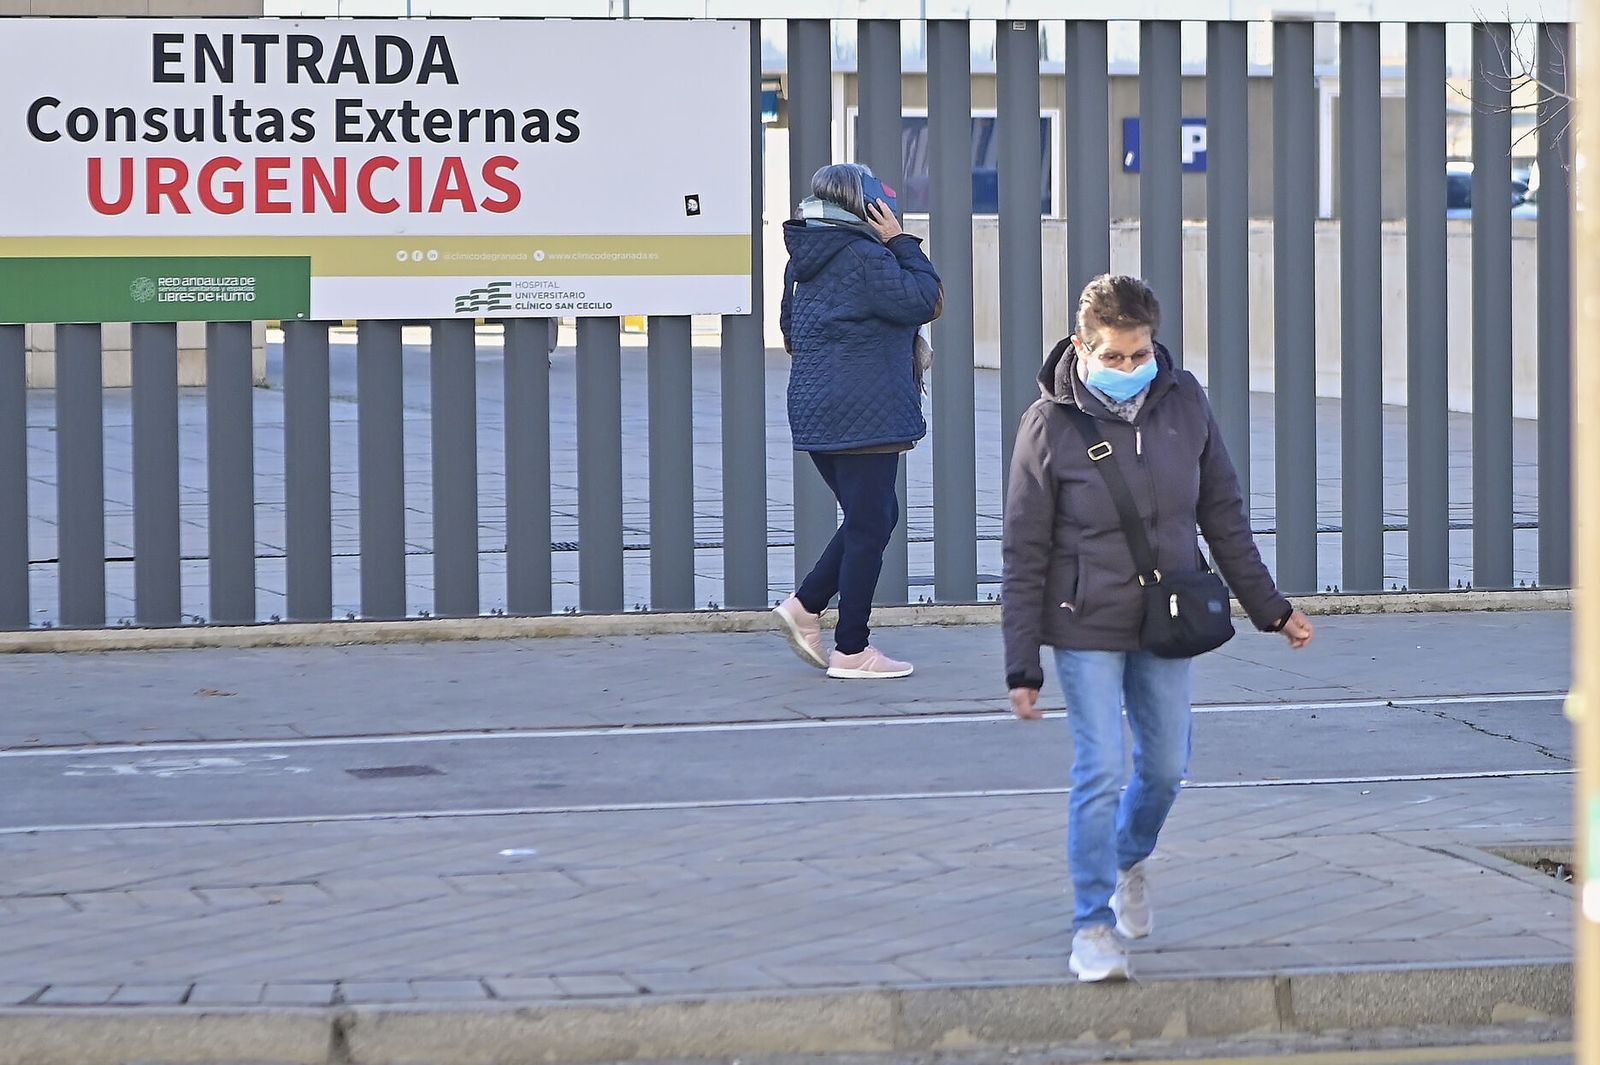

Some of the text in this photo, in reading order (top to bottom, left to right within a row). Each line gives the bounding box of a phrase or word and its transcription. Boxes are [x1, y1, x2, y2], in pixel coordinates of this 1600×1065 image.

[153, 34, 459, 84] ENTRADA
[27, 95, 580, 143] Consultas Externas
[88, 156, 521, 215] URGENCIAS
[548, 251, 659, 261] www.clinicodegranada.es
[515, 281, 560, 289] HOSPITAL
[515, 291, 586, 299] UNIVERSITARIO
[515, 300, 613, 310] CLÍNICO SAN CECILIO
